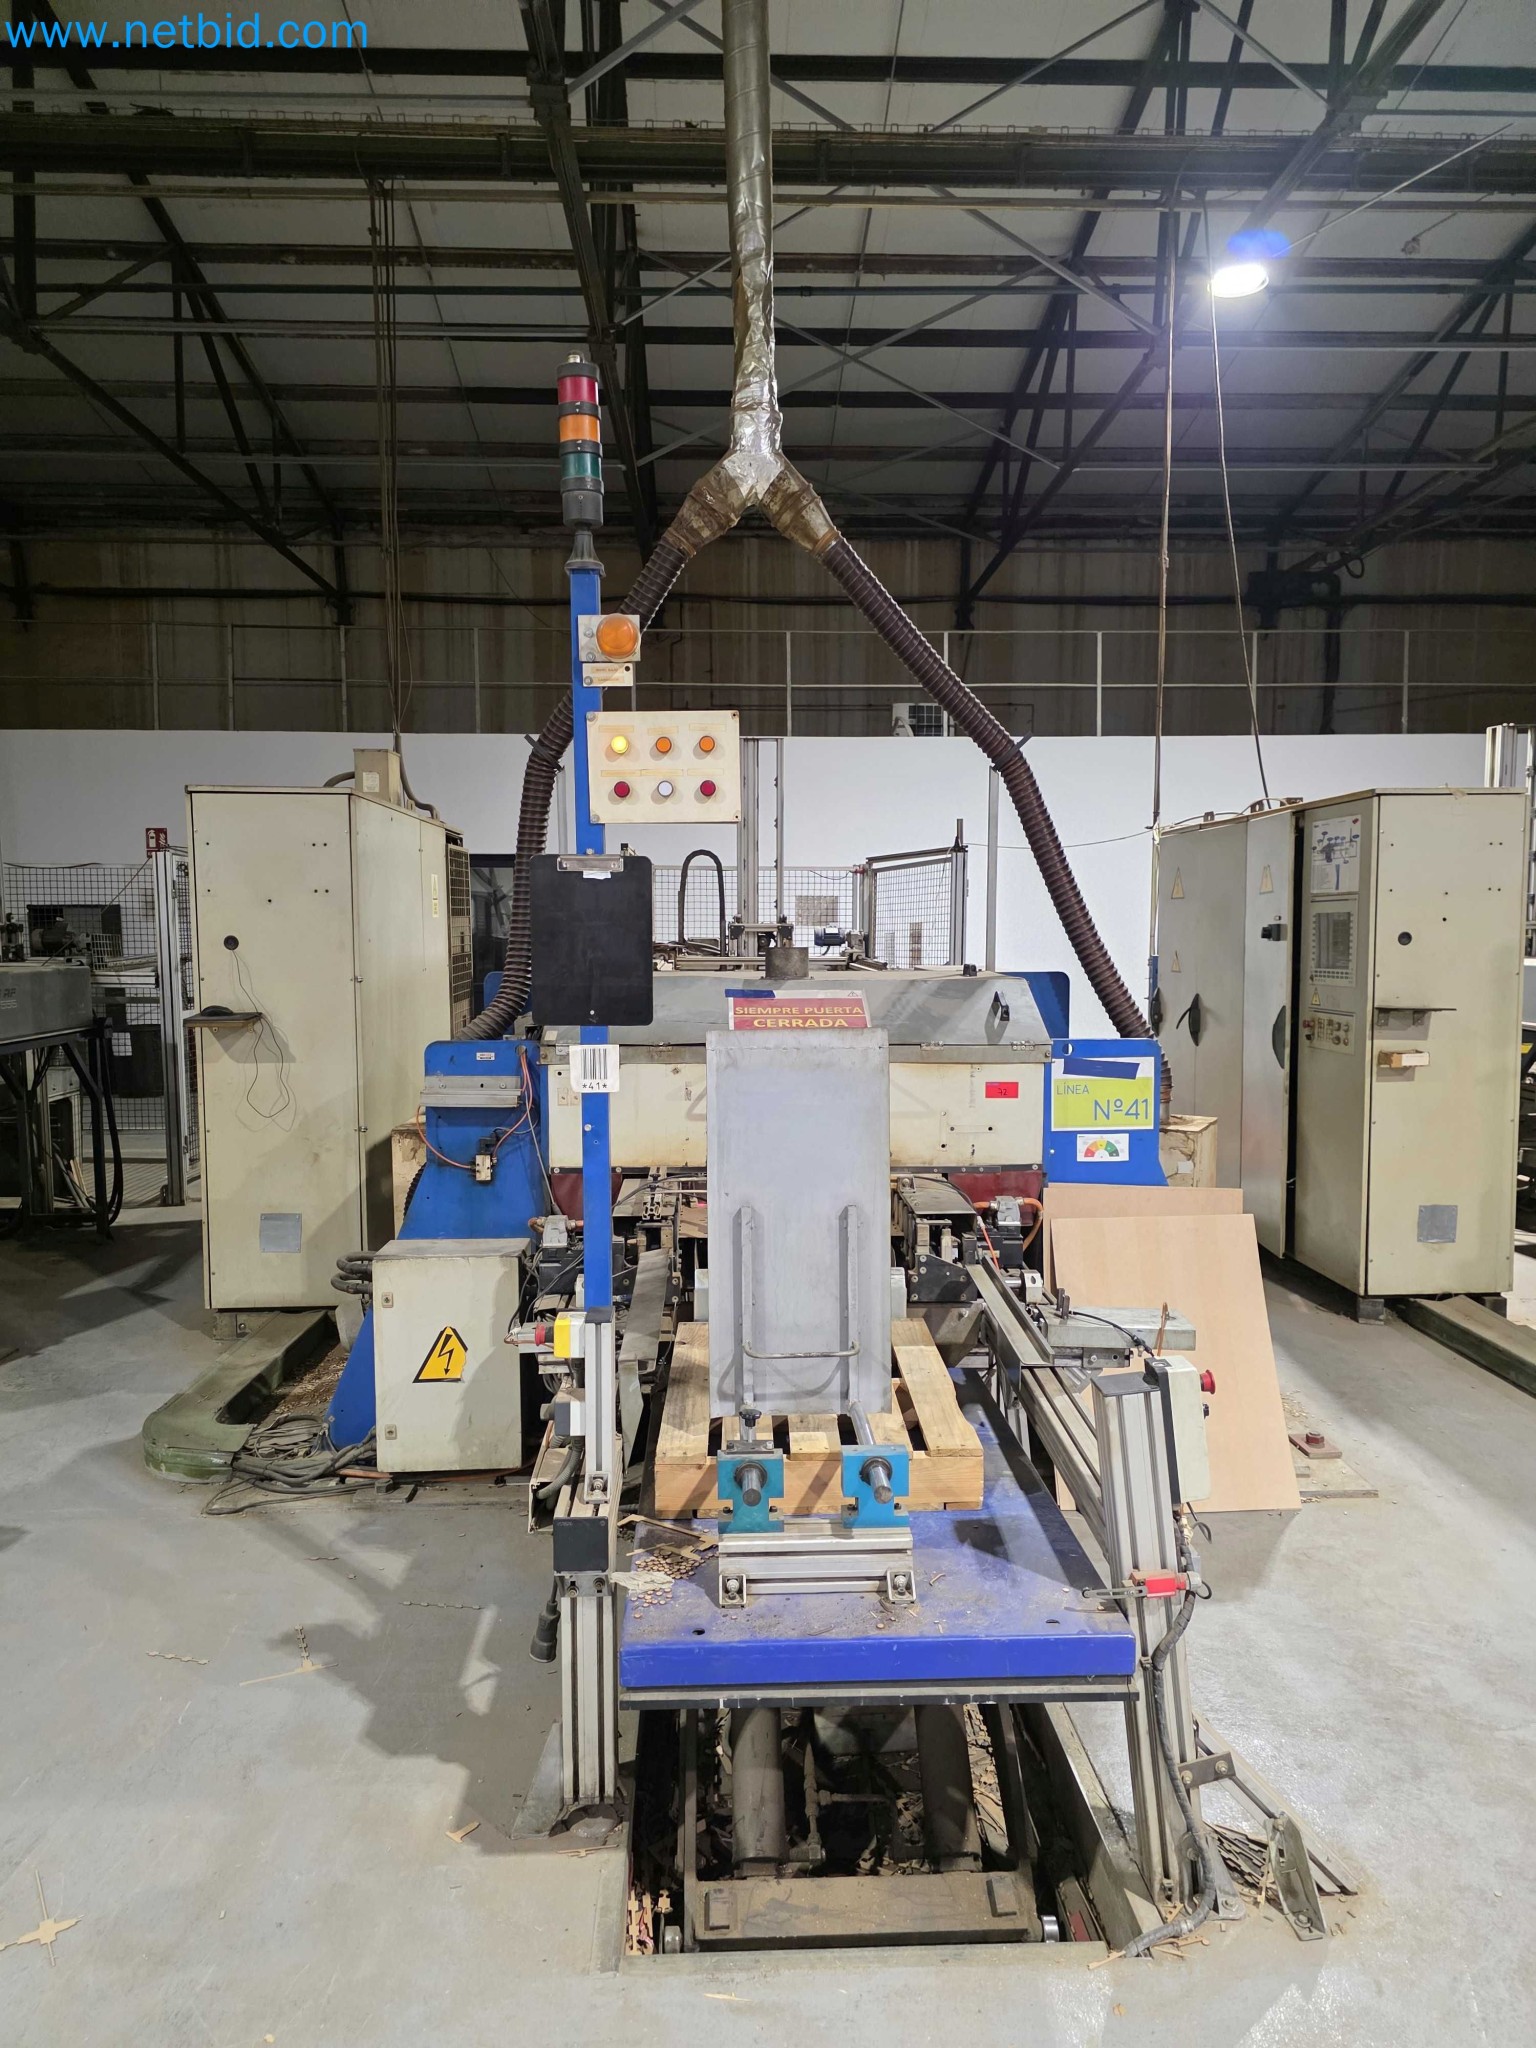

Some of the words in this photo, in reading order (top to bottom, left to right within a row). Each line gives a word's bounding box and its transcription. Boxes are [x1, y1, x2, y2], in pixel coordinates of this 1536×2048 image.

[735, 1006, 799, 1015] SIEMPRE
[804, 1006, 863, 1014] PUERTA
[753, 1018, 848, 1028] CERRADA
[1056, 1081, 1090, 1095] LÍNEA
